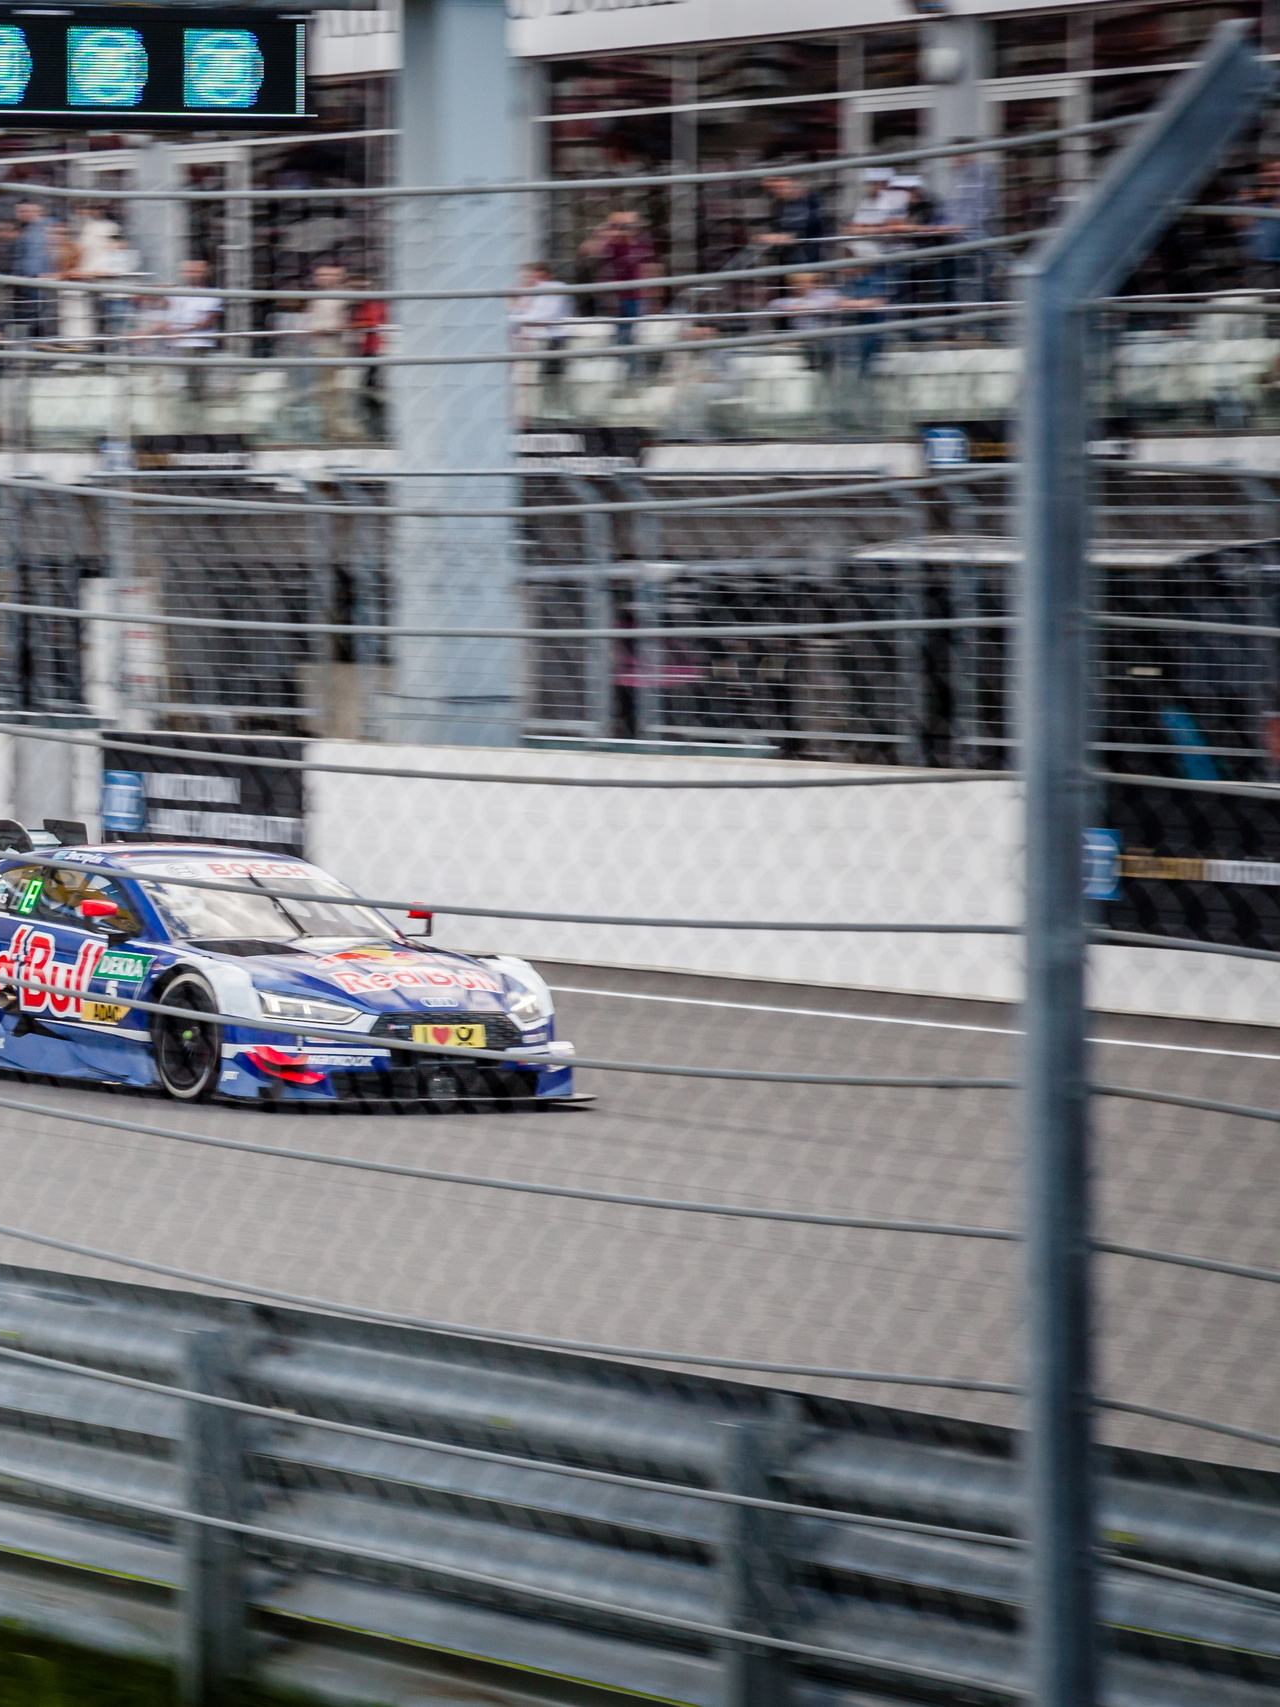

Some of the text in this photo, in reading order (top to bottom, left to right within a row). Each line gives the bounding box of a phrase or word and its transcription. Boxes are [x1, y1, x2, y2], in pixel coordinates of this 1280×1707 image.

[206, 863, 311, 877] BOSCH
[21, 934, 106, 1015] Bull
[98, 955, 144, 978] DEKRA
[105, 980, 120, 999] 5
[332, 968, 505, 995] Red Bull
[93, 1003, 123, 1023] ADAC
